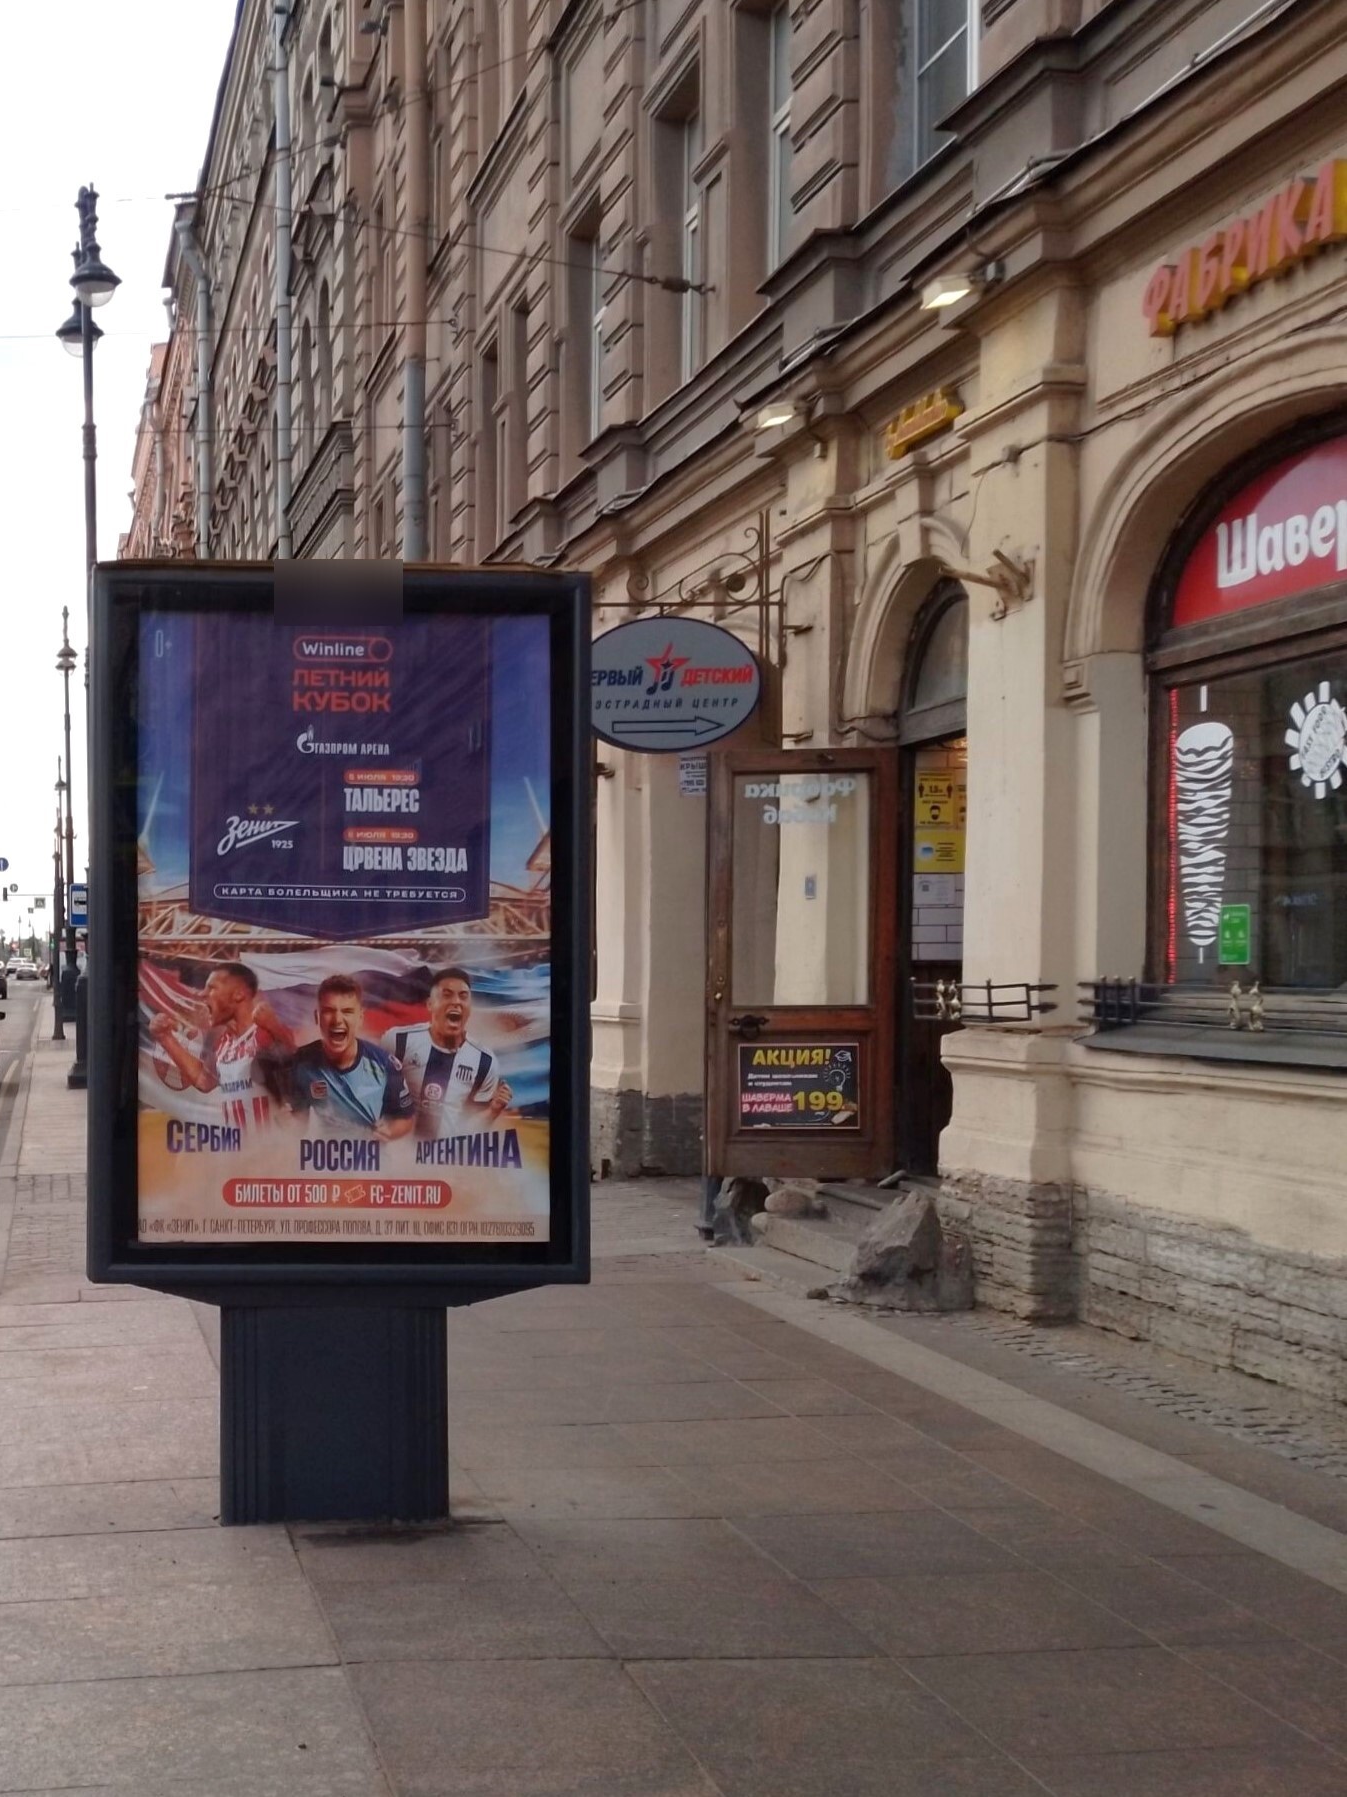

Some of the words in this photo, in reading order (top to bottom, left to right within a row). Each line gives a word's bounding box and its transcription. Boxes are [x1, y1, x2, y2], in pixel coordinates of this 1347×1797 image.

[1142, 160, 1344, 337] ФАБРИКА
[302, 641, 365, 657] Winline
[293, 666, 390, 687] ЛЕТНИЙ
[591, 666, 644, 687] ЕРВЫЙ
[681, 664, 754, 687] ДЕТСКИЙ
[293, 691, 391, 713] КУБОК
[595, 698, 683, 710] ЭСТРАДНЫЙ
[692, 697, 739, 710] ЦЕНТР
[315, 742, 357, 755] ГАЗПРОМ
[360, 743, 390, 756] АРЕНА
[356, 773, 387, 781] ИЮЛЯ
[343, 787, 420, 813] ТАЛЬЕРЕС
[217, 815, 300, 856] Зенит
[271, 840, 294, 849] 1925
[356, 831, 387, 839] ИЮЛЯ
[342, 846, 403, 871] ЦРВЕНА
[406, 847, 468, 873] ЗВЕЗДА
[221, 887, 263, 896] КАРТА
[268, 888, 359, 898] БОЛЕЛЬЩИКА
[364, 889, 380, 898] НЕ
[385, 889, 458, 899] ТРЕБУЕТСЯ
[752, 1048, 831, 1068] АКЦИЯ!
[742, 1093, 792, 1102] ШАВЕРМА
[742, 1103, 750, 1113] В
[751, 1103, 793, 1113] ЛАВАШЕ
[167, 1119, 241, 1153] СЕРБИЯ
[300, 1139, 380, 1171] РОССИЯ
[416, 1129, 523, 1169] АРГЕНТИНА
[235, 1184, 284, 1204] БИЛЕТЫ
[287, 1184, 302, 1204] ОТ
[305, 1184, 328, 1204] 500
[370, 1185, 441, 1205] FC-ZENIT.RU
